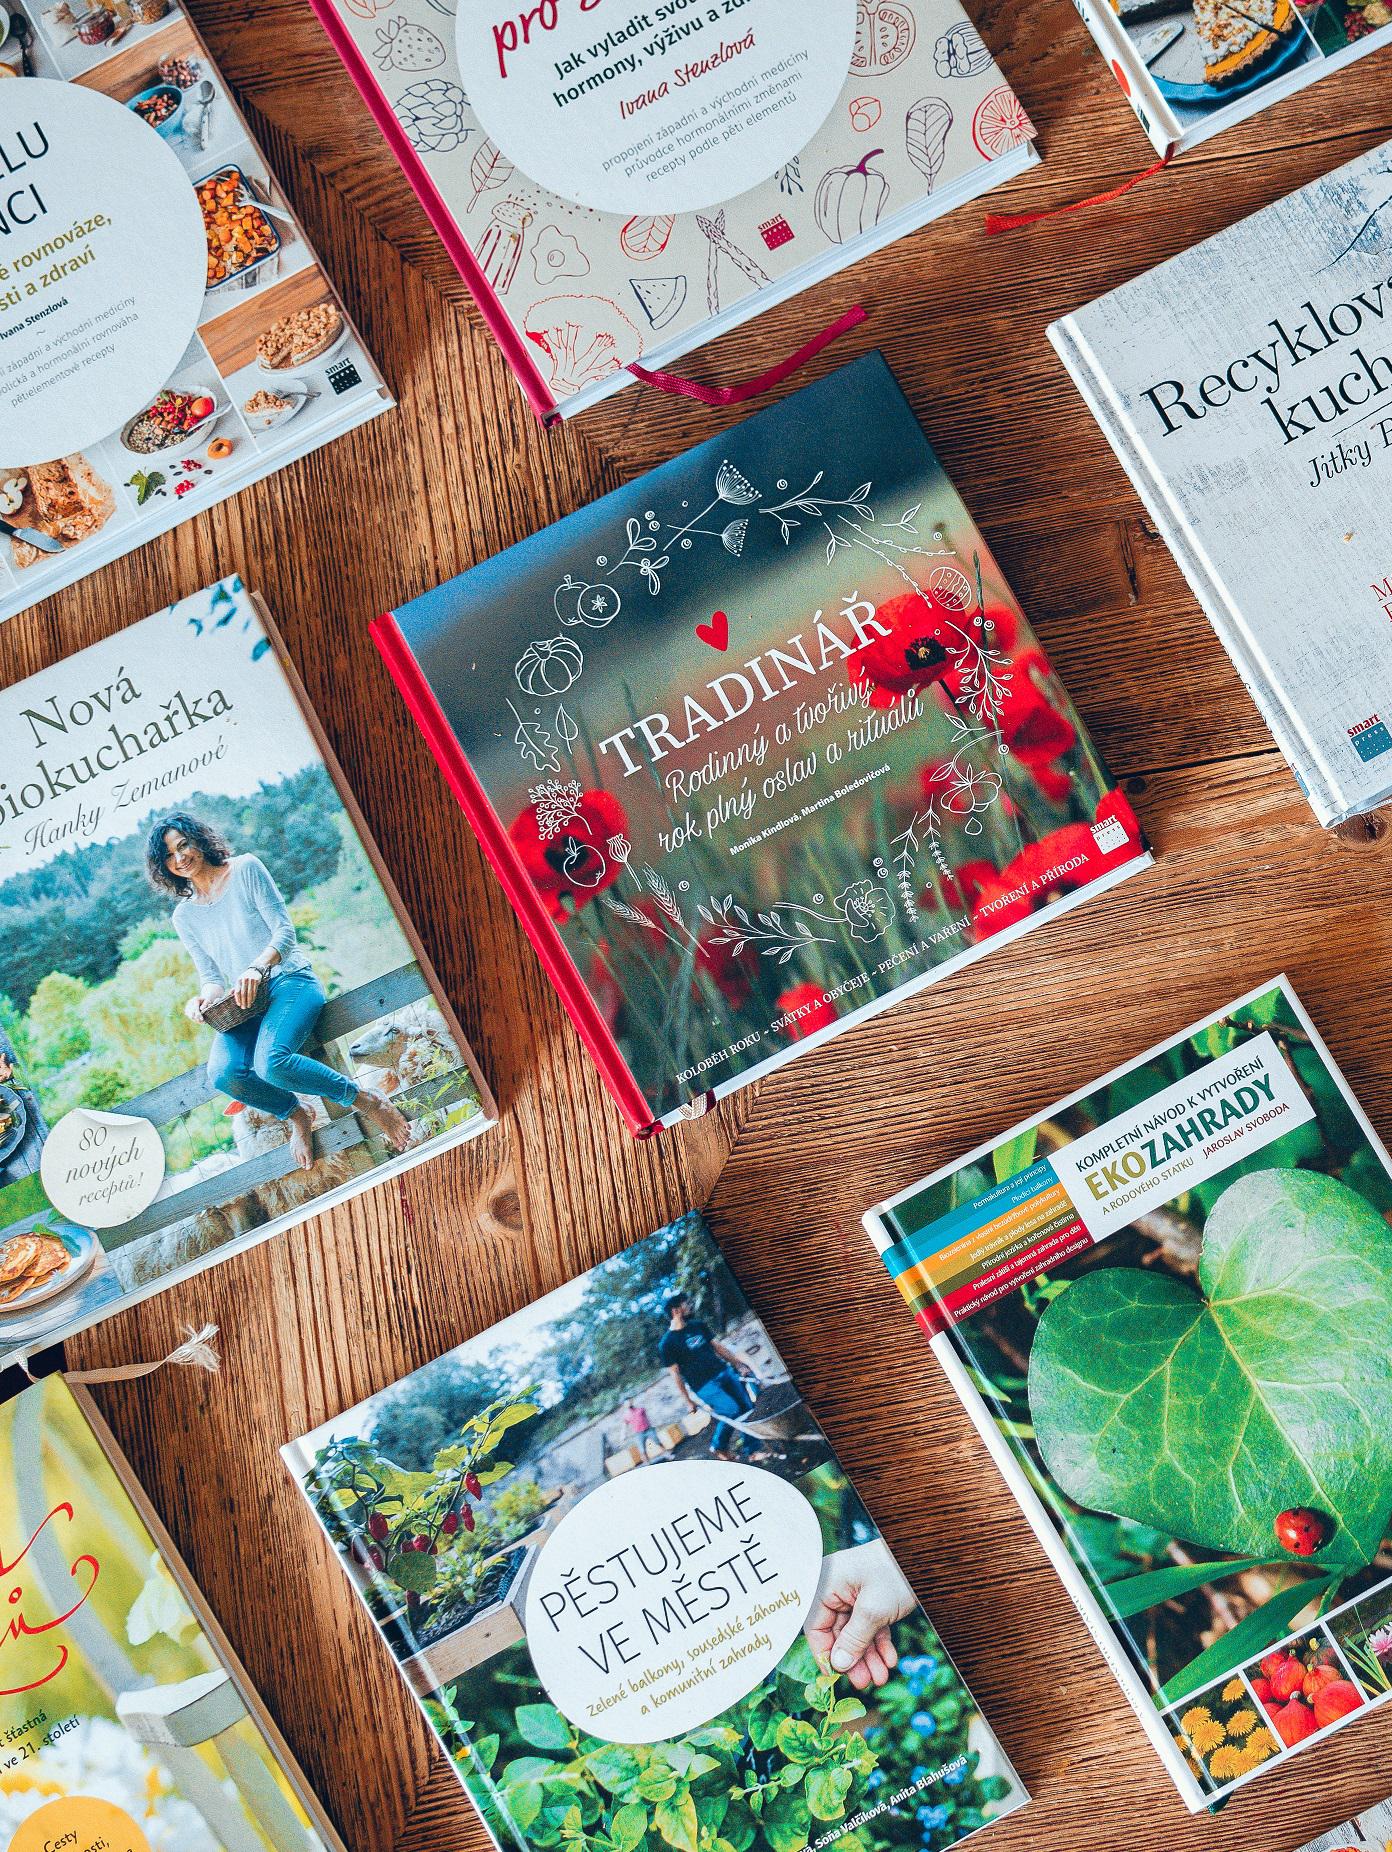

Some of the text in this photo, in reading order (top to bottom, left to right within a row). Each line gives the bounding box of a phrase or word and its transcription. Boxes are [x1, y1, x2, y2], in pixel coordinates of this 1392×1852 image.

[552, 9, 719, 107] hormony, výživu a
[554, 14, 653, 80] Jak vyladit
[620, 27, 755, 119] Ivana Stenzlová
[601, 49, 808, 172] propojení západní a východní medicíny
[12, 214, 111, 272] rovnováze,
[757, 213, 783, 231] smart
[24, 244, 95, 295] a zdraví
[24, 296, 68, 326] Stenzlová
[1308, 440, 1371, 487] Jitky
[19, 666, 142, 749] Nová
[598, 590, 893, 778] TRADINÁŘ
[1347, 713, 1382, 737] smart
[0, 688, 234, 826] iokuchařka
[658, 688, 923, 852] rok plný oslav a rituálů
[665, 668, 872, 803] Rodinný a tvořivý
[24, 735, 229, 855] Hanky Zemanové
[1089, 814, 1119, 835] smart
[675, 853, 1088, 1084] KOLOBĚH ROKU SVÁTKY A OBYČEJE PEČENÍ A VAŘENÍ TVOŘENÍ A PŘÍRODA
[79, 1126, 108, 1151] 80
[1075, 1055, 1264, 1172] KOMPLETNÍ NÁVOD K VYTVOŘENÍ
[1083, 1072, 1277, 1202] EKOZAHRADY
[1202, 1102, 1289, 1159] JAROSLAV SVOBODA
[66, 1137, 144, 1183] nových
[80, 1172, 144, 1206] receptů!
[1102, 1156, 1193, 1215] A RODOVÉHO STATKU
[539, 1480, 763, 1633] PĚSTUJEME
[578, 1533, 779, 1675] VE MĚSTĚ
[585, 1589, 800, 1716] Zelené balkony, sousedské záhonky
[640, 1633, 771, 1715] a komunitní zahrady
[3, 1708, 46, 1742] šťastná
[3, 1713, 79, 1768] ve 21. století
[817, 1754, 968, 1849] Soňa Valčíková, Anita Blahušová
